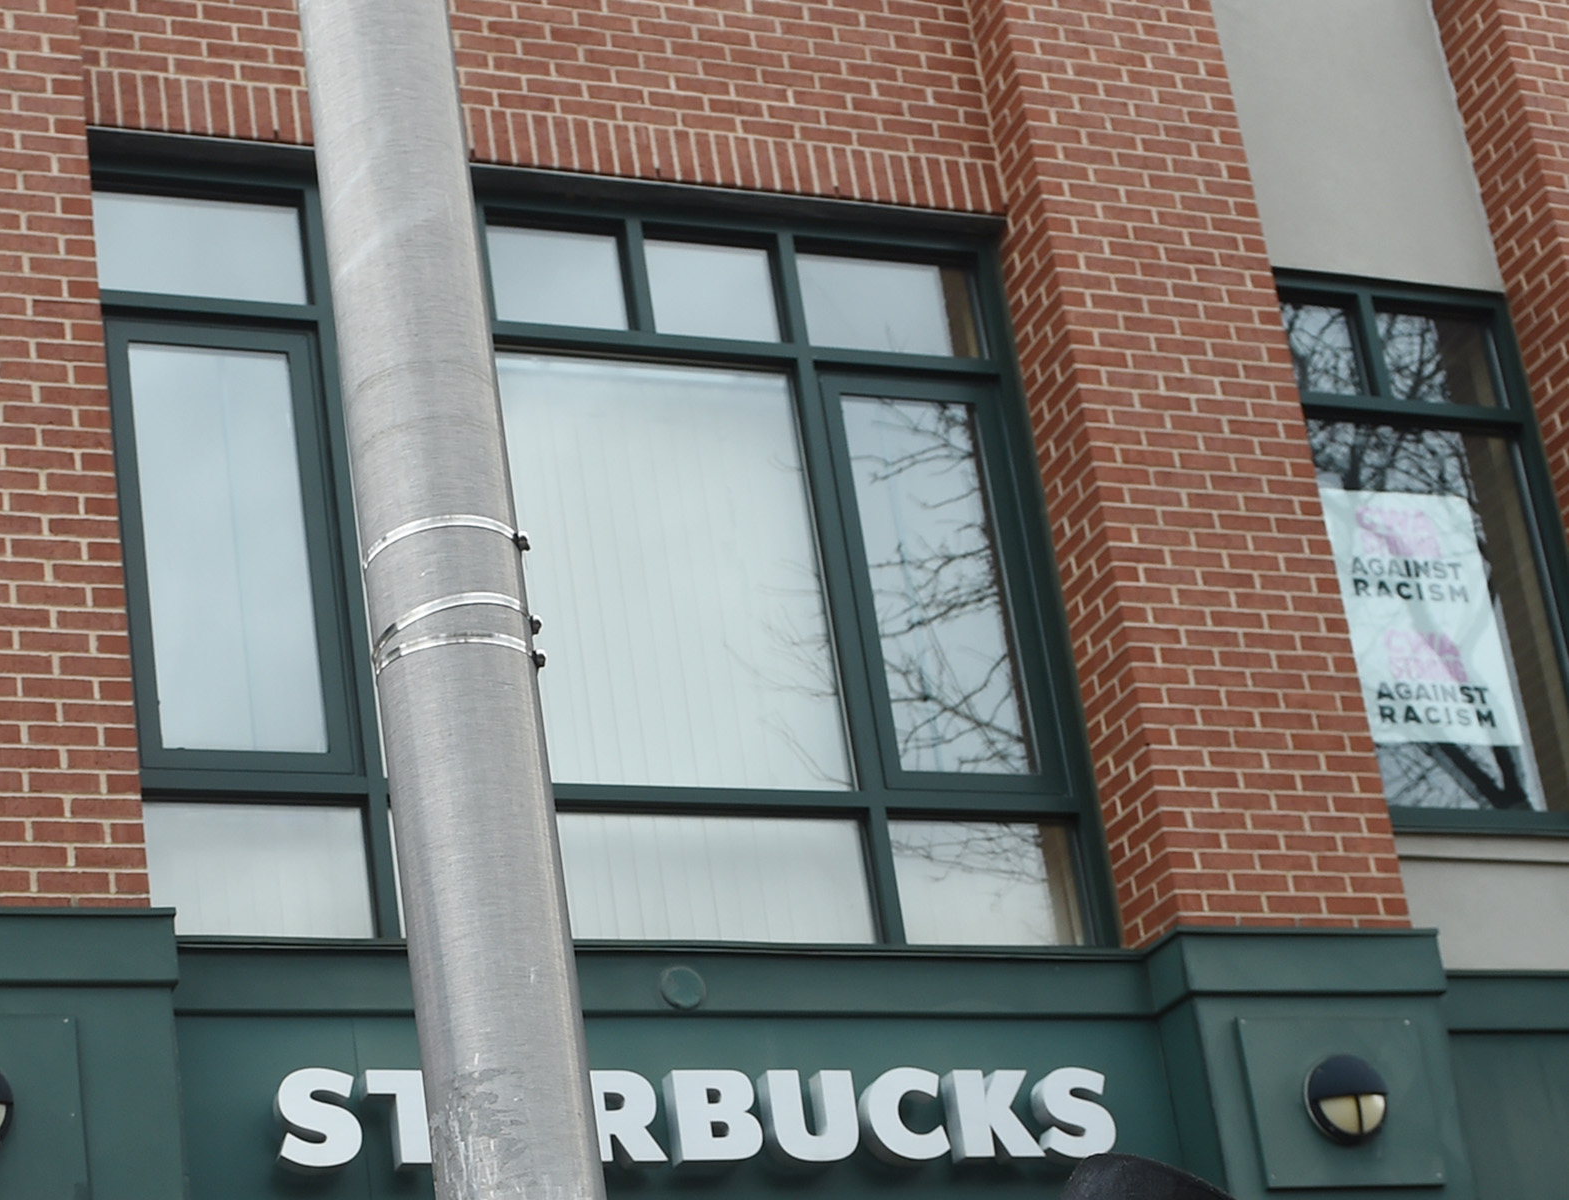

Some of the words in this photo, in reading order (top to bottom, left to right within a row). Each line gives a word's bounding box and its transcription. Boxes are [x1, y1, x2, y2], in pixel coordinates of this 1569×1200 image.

[1351, 557, 1463, 580] AGAINST
[1354, 579, 1469, 602] RACISM
[1377, 682, 1490, 704] AGAINST
[1379, 705, 1497, 728] RACISM
[275, 1066, 1118, 1170] STRBUCKS
